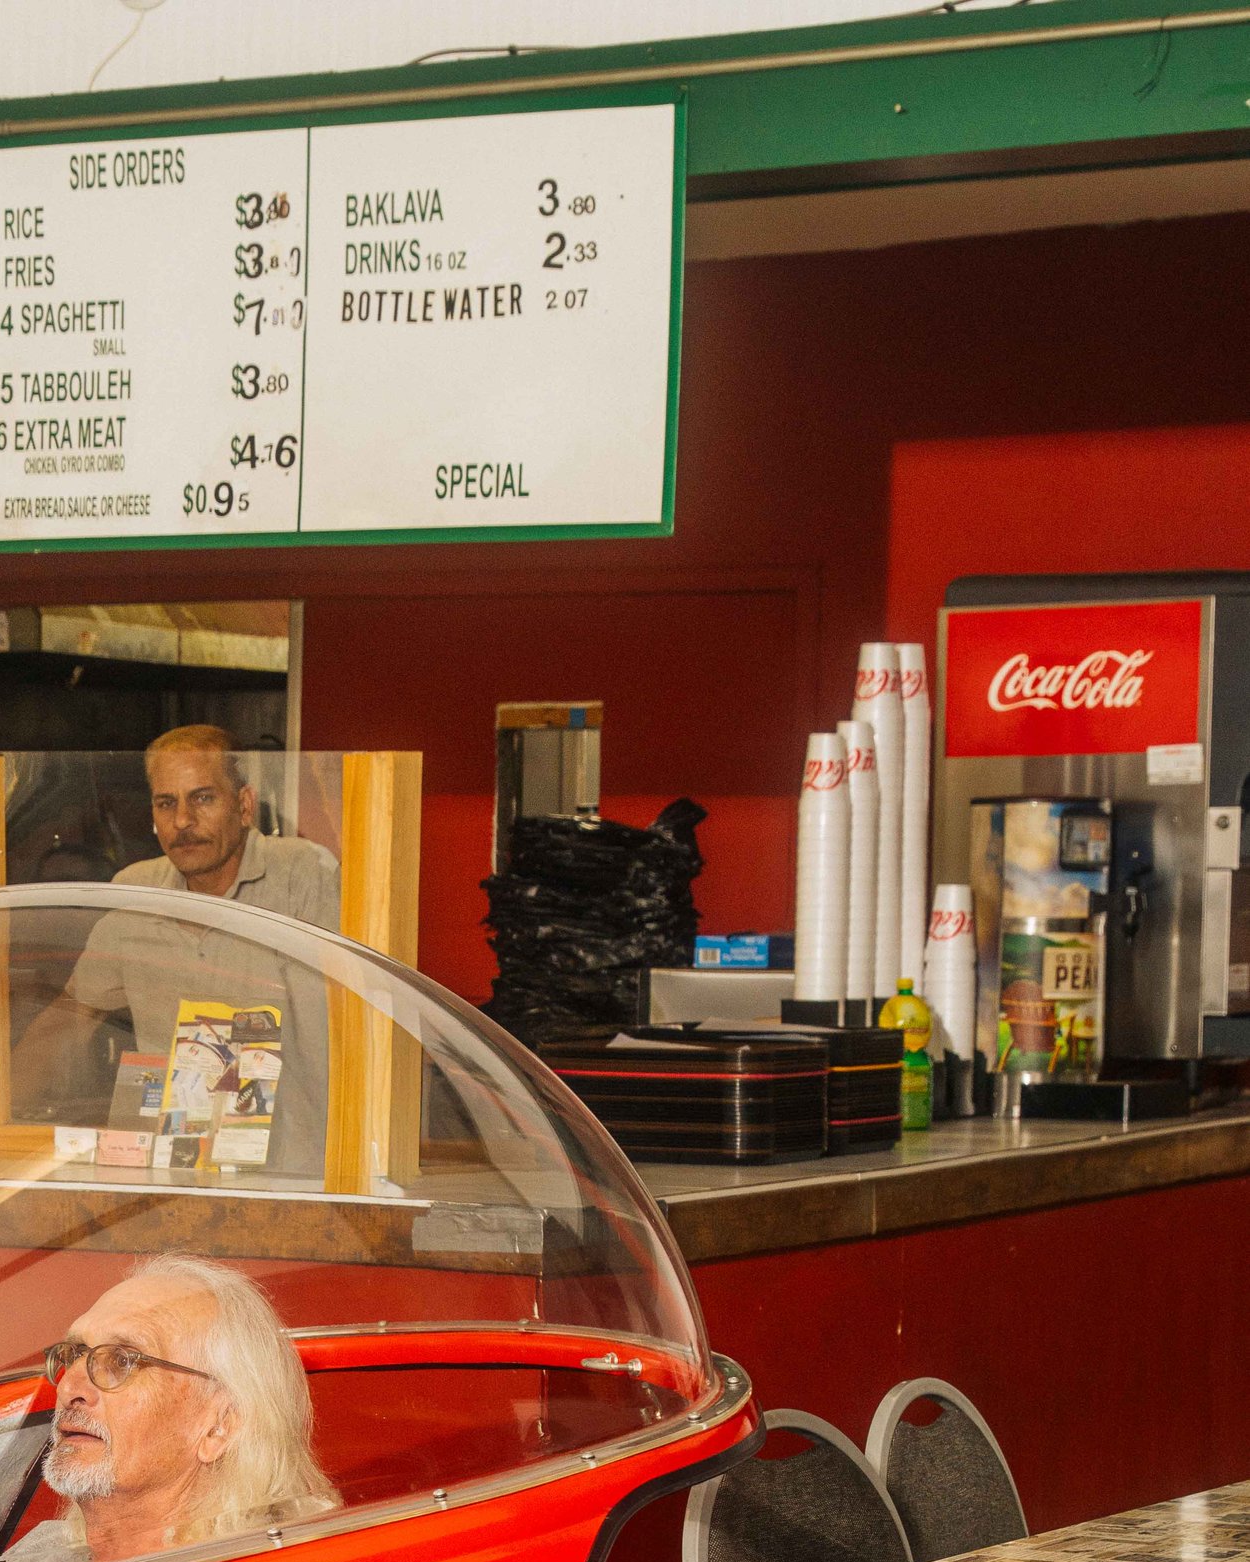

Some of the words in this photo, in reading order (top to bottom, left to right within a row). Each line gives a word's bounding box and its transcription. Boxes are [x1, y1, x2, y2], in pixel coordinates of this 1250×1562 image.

[70, 154, 107, 191] SIDE
[113, 148, 185, 187] ORDERS
[4, 206, 44, 240] RICE
[346, 189, 443, 227] BAKLAVA
[4, 256, 55, 288] FRIES
[345, 239, 421, 275] DRINKS
[426, 253, 443, 271] 16
[449, 252, 467, 270] OZ
[21, 300, 125, 336] SPAGHETTI
[342, 291, 435, 322] BOTTLE
[443, 283, 522, 320] WATER
[93, 338, 126, 356] SMALL
[21, 369, 131, 403] TABBOULEH
[14, 419, 73, 451] EXTRA
[78, 416, 127, 448] MEAT
[61, 456, 82, 472] GYRO
[85, 455, 95, 472] OR
[97, 454, 125, 471] COMBO
[435, 463, 529, 499] SPECIAL
[5, 498, 32, 518] EXTRA
[101, 497, 114, 516] OR
[116, 495, 150, 516] CHEESE
[987, 650, 1154, 711] Coca-Cola
